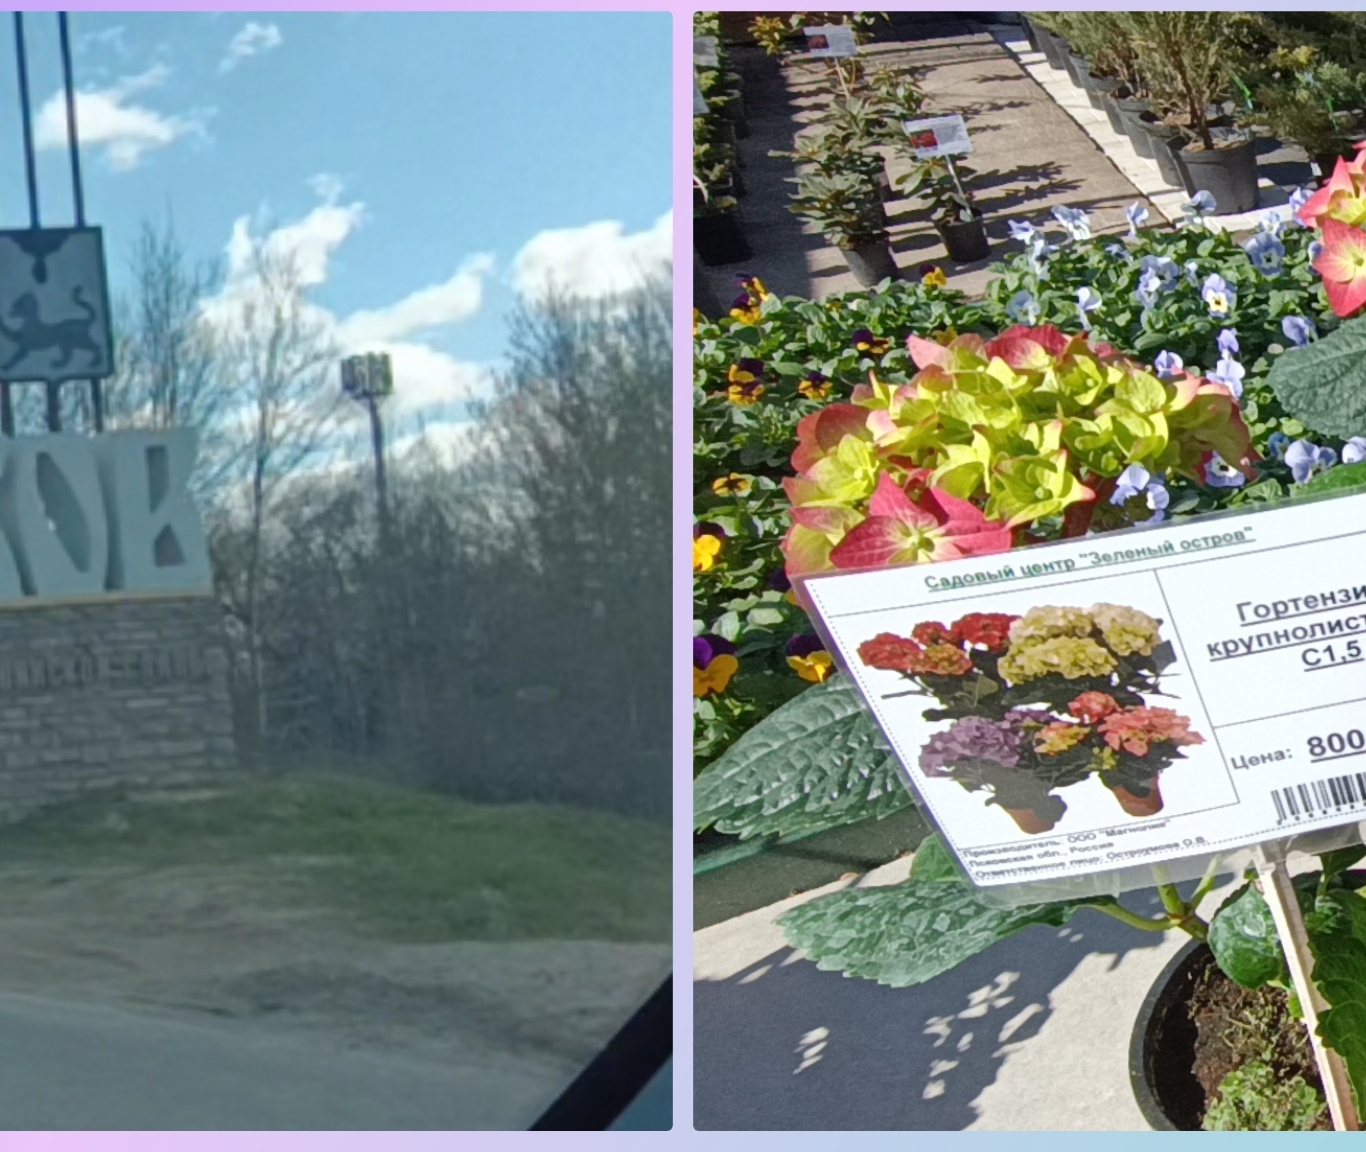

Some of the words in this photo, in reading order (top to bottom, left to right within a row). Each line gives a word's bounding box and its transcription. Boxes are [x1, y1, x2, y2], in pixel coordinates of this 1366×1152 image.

[923, 561, 1015, 591] Садовый
[1019, 553, 1076, 581] центр
[1079, 538, 1175, 568] "Зеленый
[1179, 526, 1254, 554] остров"
[1301, 640, 1362, 667] С1,5
[1230, 748, 1293, 771] Цена:
[962, 837, 1065, 858] Производитель:
[1067, 832, 1097, 844] ООО
[1098, 819, 1171, 838] "Магнолия"
[968, 853, 1034, 868] Псковская
[1069, 841, 1115, 854] Россия
[974, 860, 1067, 880] Ответственное
[1069, 855, 1104, 867] лицо:
[1106, 841, 1180, 861] Остроумова
